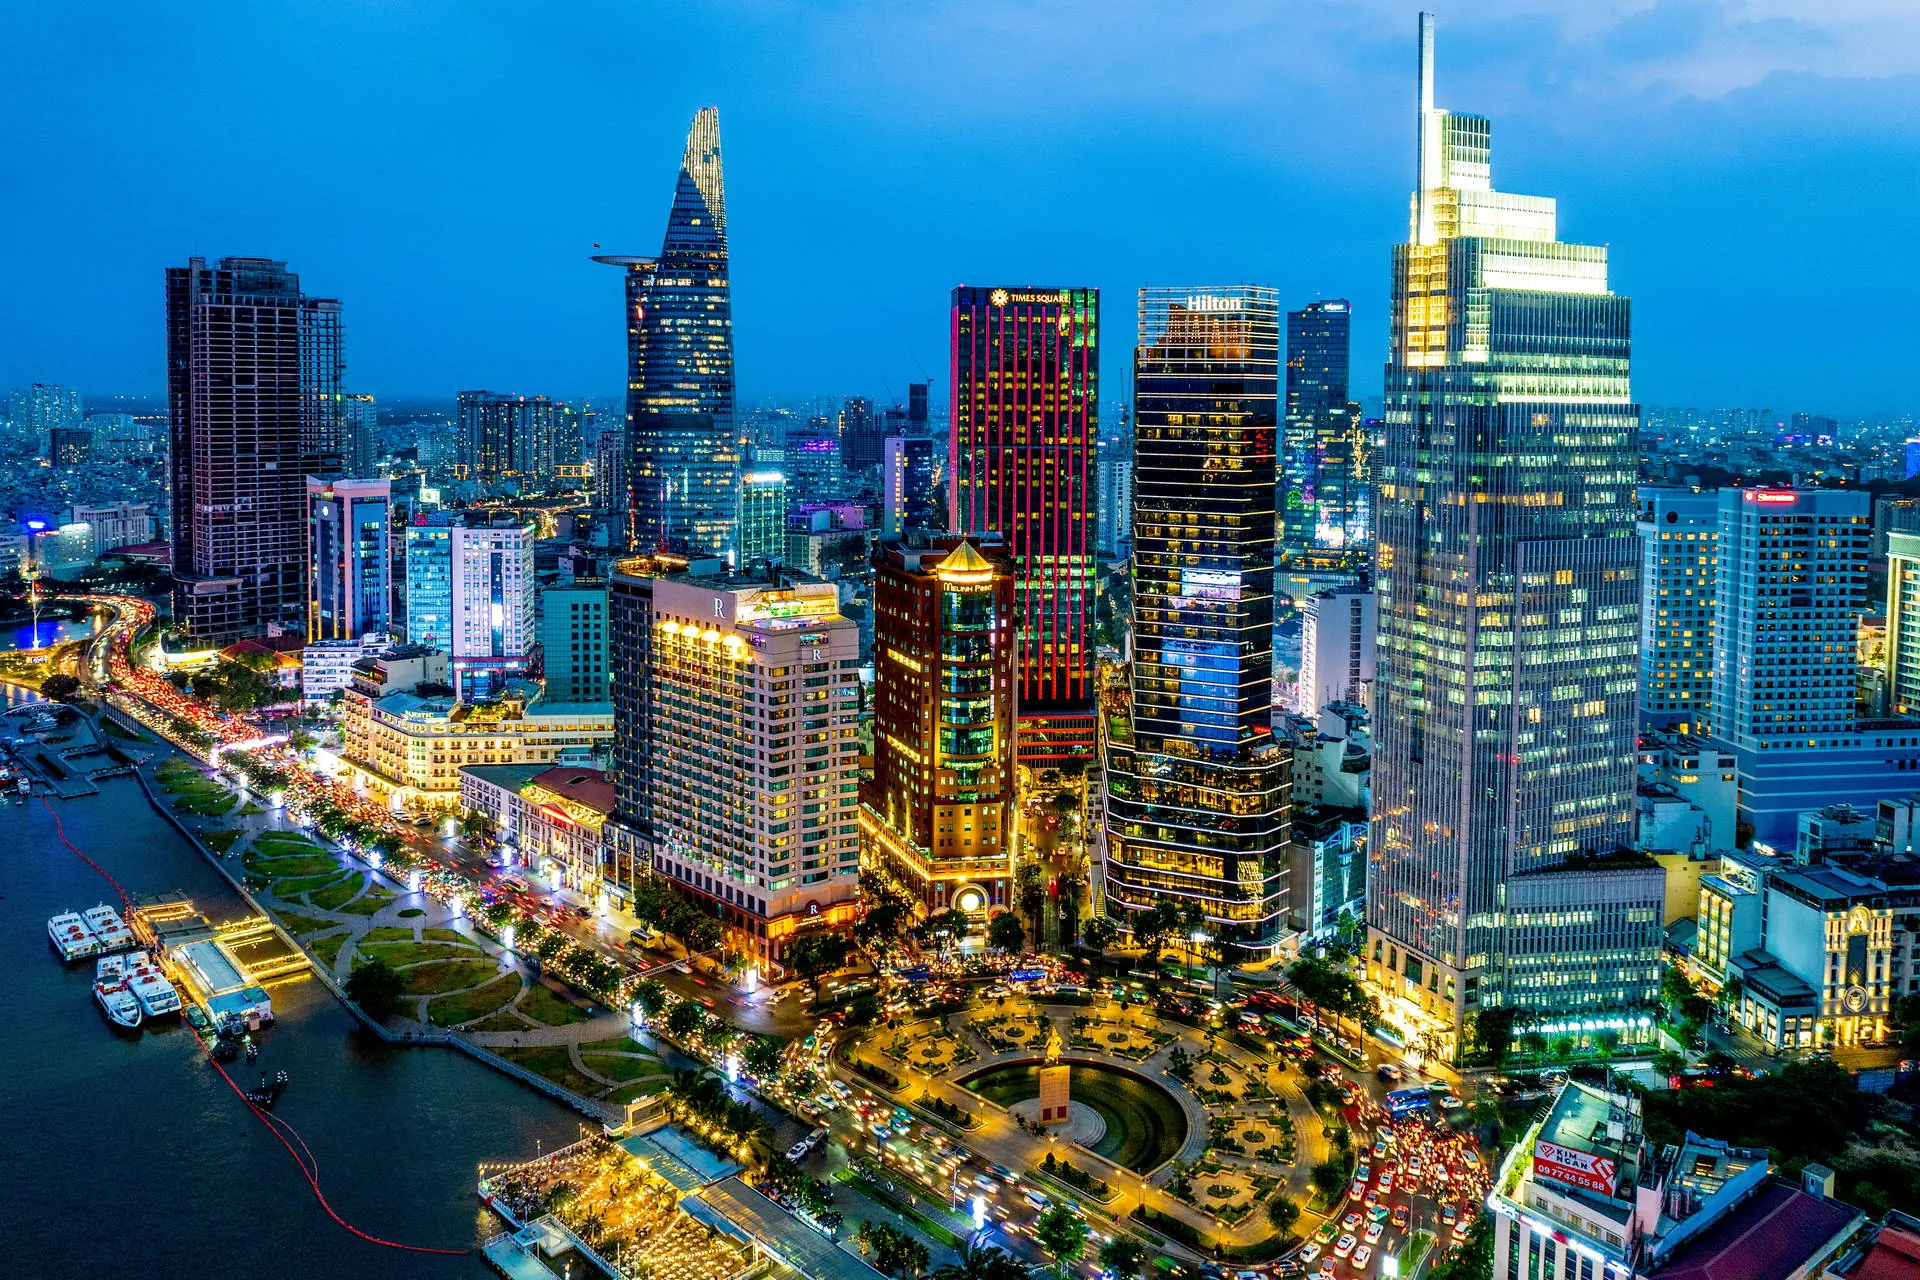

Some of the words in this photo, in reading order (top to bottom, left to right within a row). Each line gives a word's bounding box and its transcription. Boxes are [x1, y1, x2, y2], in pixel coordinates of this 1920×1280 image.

[1011, 294, 1035, 302] TIMES
[1036, 294, 1069, 304] SQUARE
[1188, 294, 1240, 311] Hilton
[714, 598, 726, 618] R
[813, 648, 823, 660] R
[810, 904, 818, 914] R
[1556, 1149, 1577, 1159] KIM
[1556, 1155, 1587, 1170] NGAN
[1578, 1177, 1591, 1187] 55
[1592, 1181, 1605, 1191] 88
